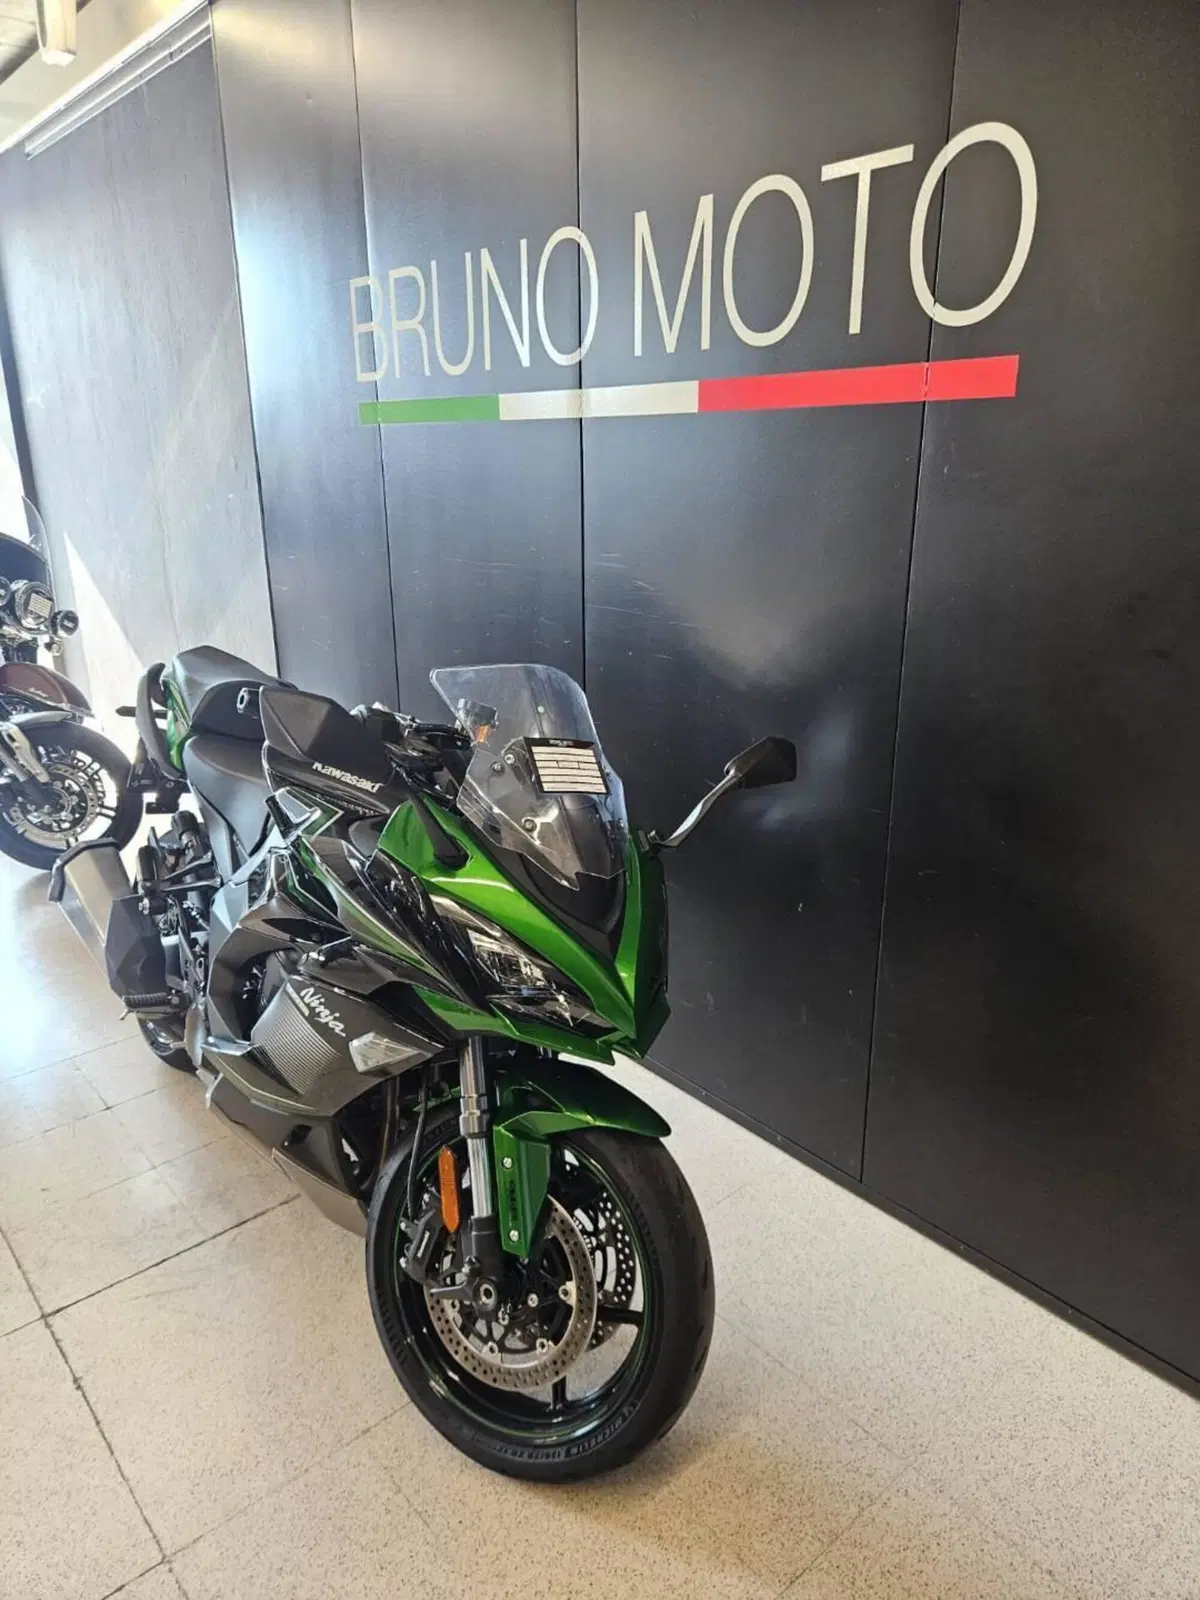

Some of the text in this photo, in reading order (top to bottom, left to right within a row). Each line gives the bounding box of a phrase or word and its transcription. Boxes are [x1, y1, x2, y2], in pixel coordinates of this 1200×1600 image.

[349, 121, 1038, 382] BRUNO MOTO
[300, 987, 346, 1037] Ninja
